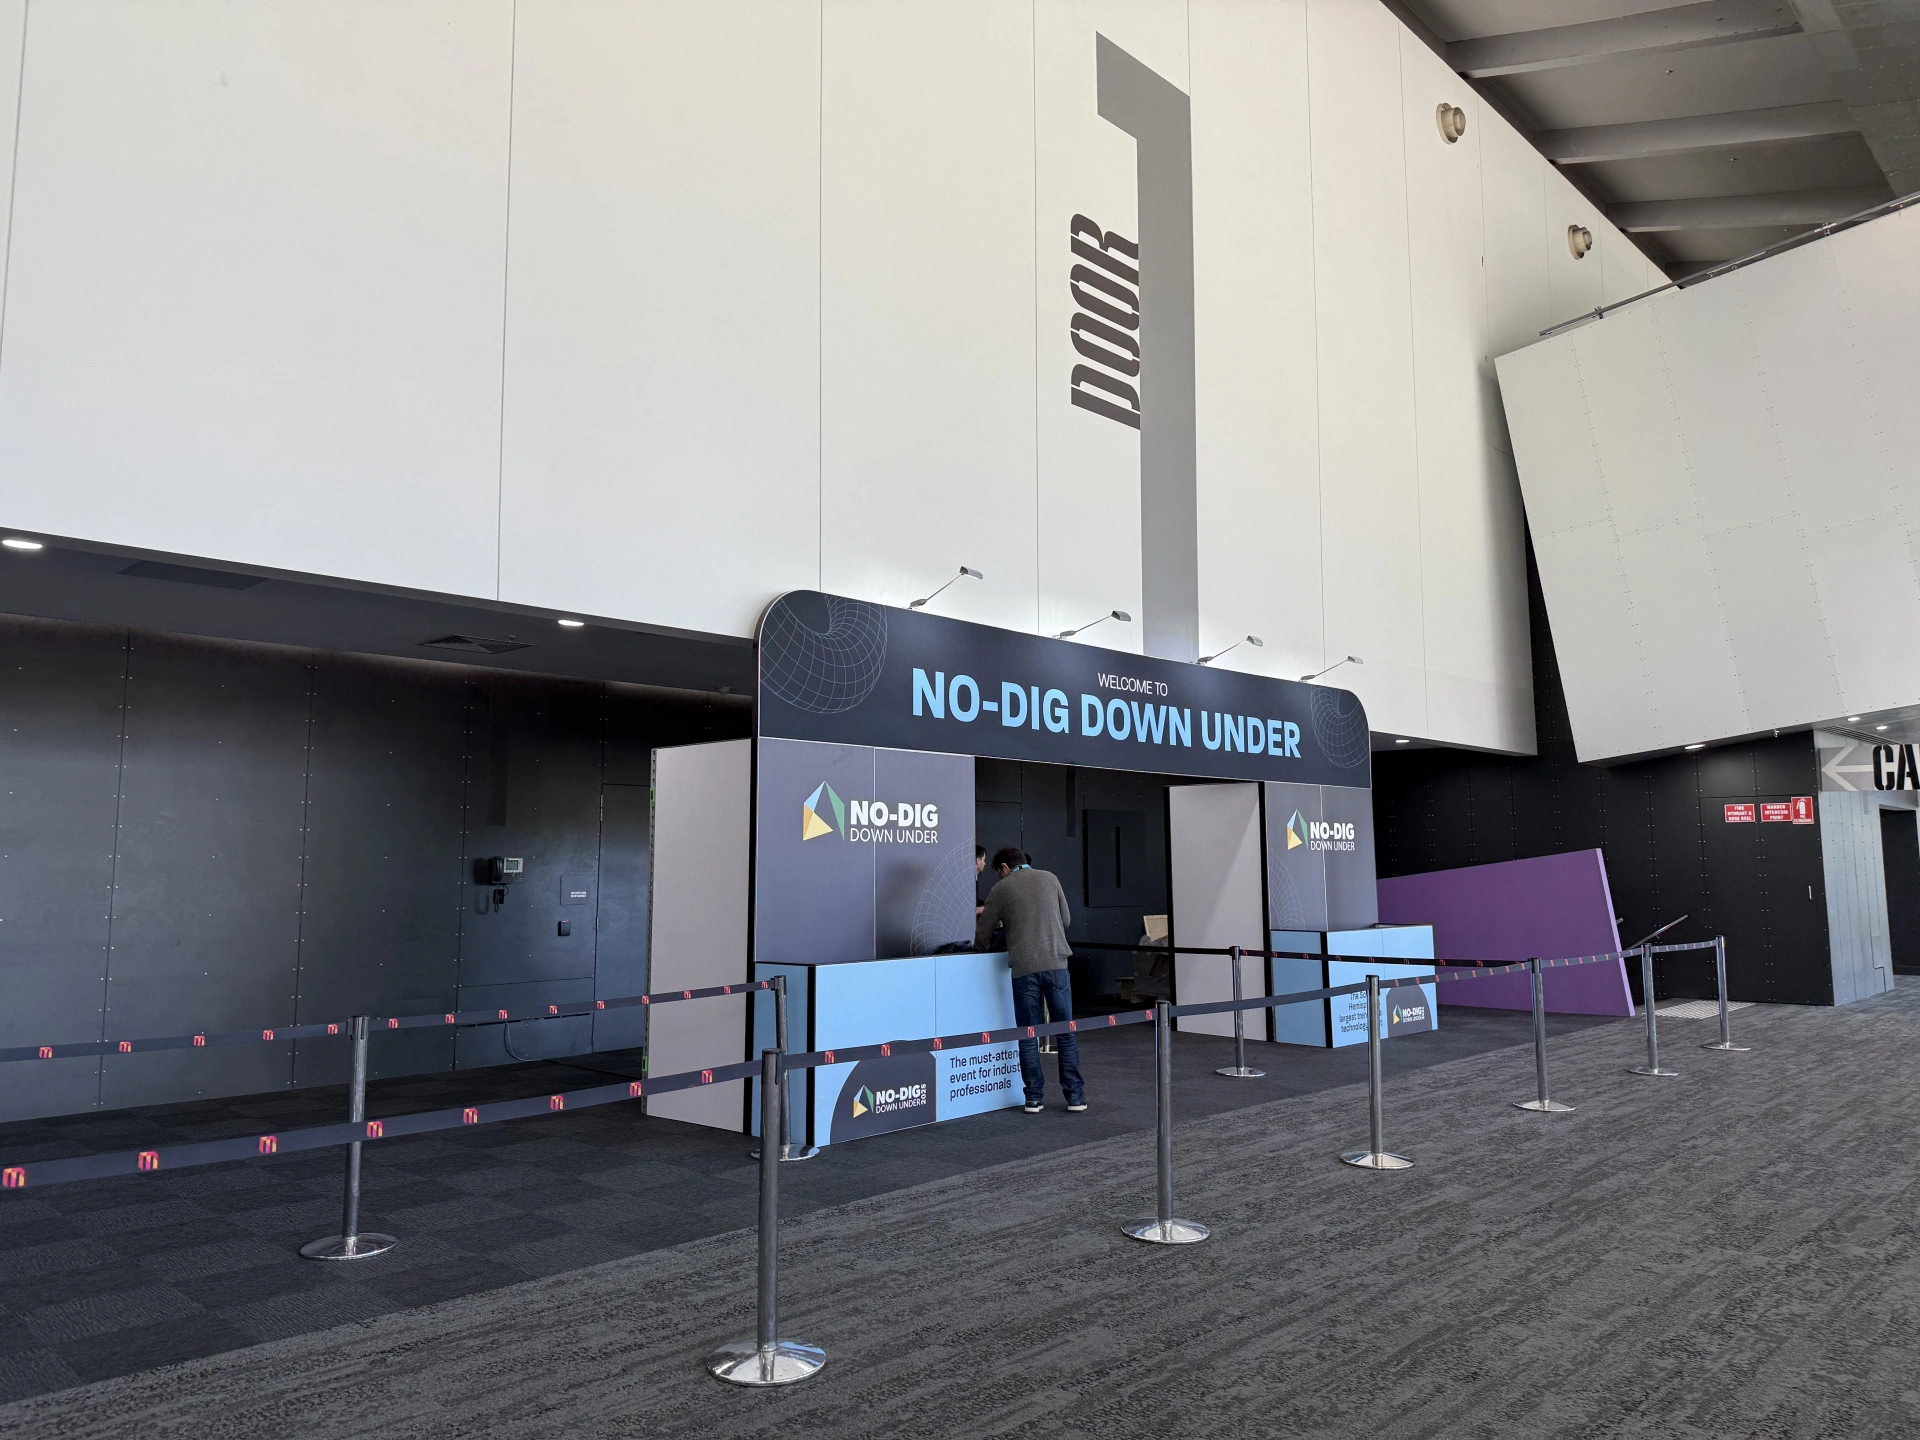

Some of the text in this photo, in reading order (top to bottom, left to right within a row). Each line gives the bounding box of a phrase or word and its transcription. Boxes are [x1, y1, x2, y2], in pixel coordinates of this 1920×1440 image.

[1070, 214, 1141, 430] DOOR
[1098, 672, 1168, 697] WELCOME TO
[912, 668, 1302, 758] NO-DIG DOWN UNDER
[1872, 744, 1920, 791] CA
[850, 800, 939, 828] NO-DIG
[850, 828, 939, 844] DOWN UNDER
[1309, 821, 1355, 840] NO-DIG
[1310, 840, 1355, 851] DOWN UNDER
[1348, 1001, 1367, 1011] Hemisp
[950, 1049, 1019, 1069] The must-atten
[950, 1062, 1021, 1084] event for indust
[876, 1084, 921, 1105] NO-DIG
[950, 1077, 1012, 1102] professionals
[875, 1098, 921, 1114] DOWN UNDER
